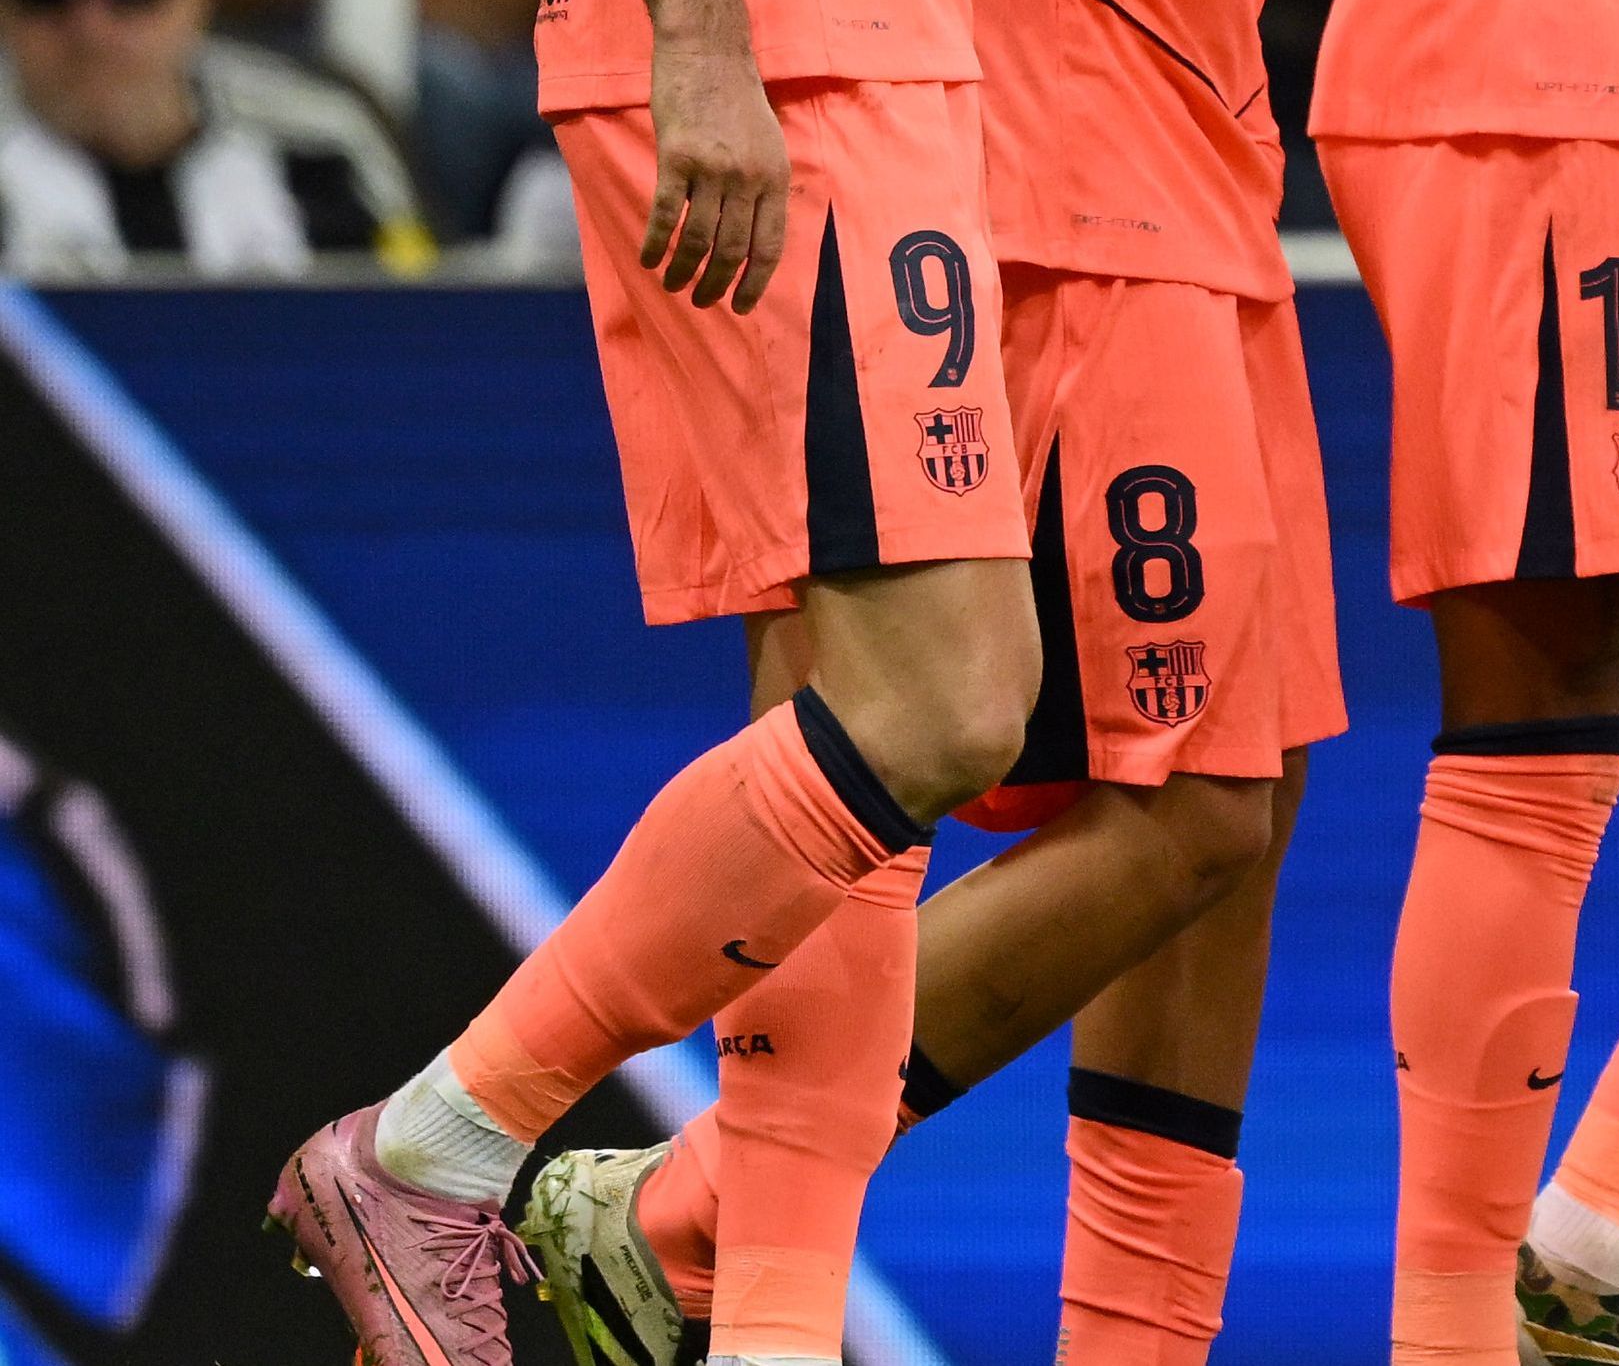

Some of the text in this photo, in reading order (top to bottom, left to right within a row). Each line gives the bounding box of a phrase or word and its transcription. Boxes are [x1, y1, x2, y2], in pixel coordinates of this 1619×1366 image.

[889, 229, 976, 388] 9
[942, 443, 968, 455] FCB
[1104, 463, 1206, 623] 8
